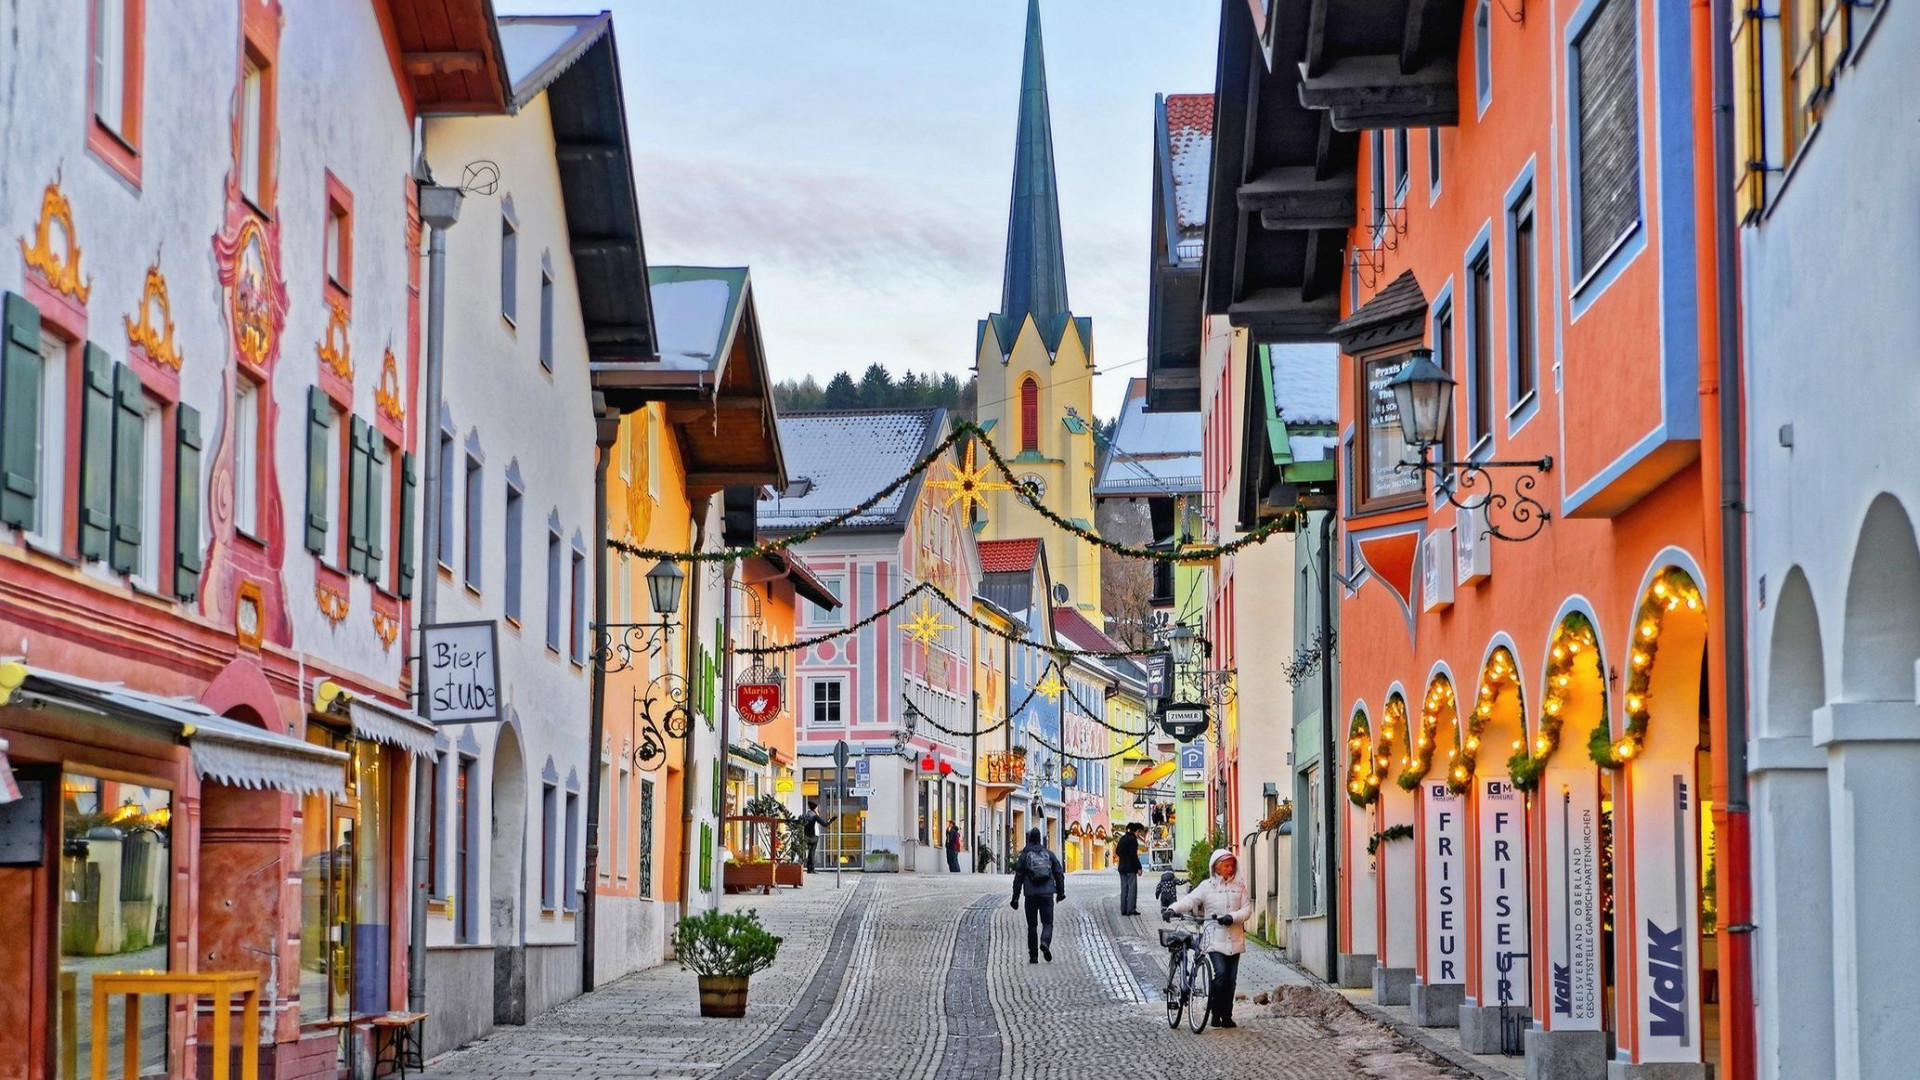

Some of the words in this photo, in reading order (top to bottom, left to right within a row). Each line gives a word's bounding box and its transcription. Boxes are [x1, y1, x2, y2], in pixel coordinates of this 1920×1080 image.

[1374, 364, 1401, 378] Praxis
[432, 642, 487, 669] Bier
[433, 668, 495, 711] stube
[743, 687, 775, 695] Maria's
[1188, 753, 1198, 767] P
[1439, 812, 1456, 980] FRISEUR
[1573, 847, 1582, 917] OBERLAND
[1583, 809, 1593, 936] GARMISCH-PARTENKIRCHEN
[1494, 812, 1512, 1001] FRISEUR
[1553, 962, 1571, 1014] VdK
[1575, 924, 1584, 1019] KREISVERBAND
[1647, 918, 1683, 1036] VdK
